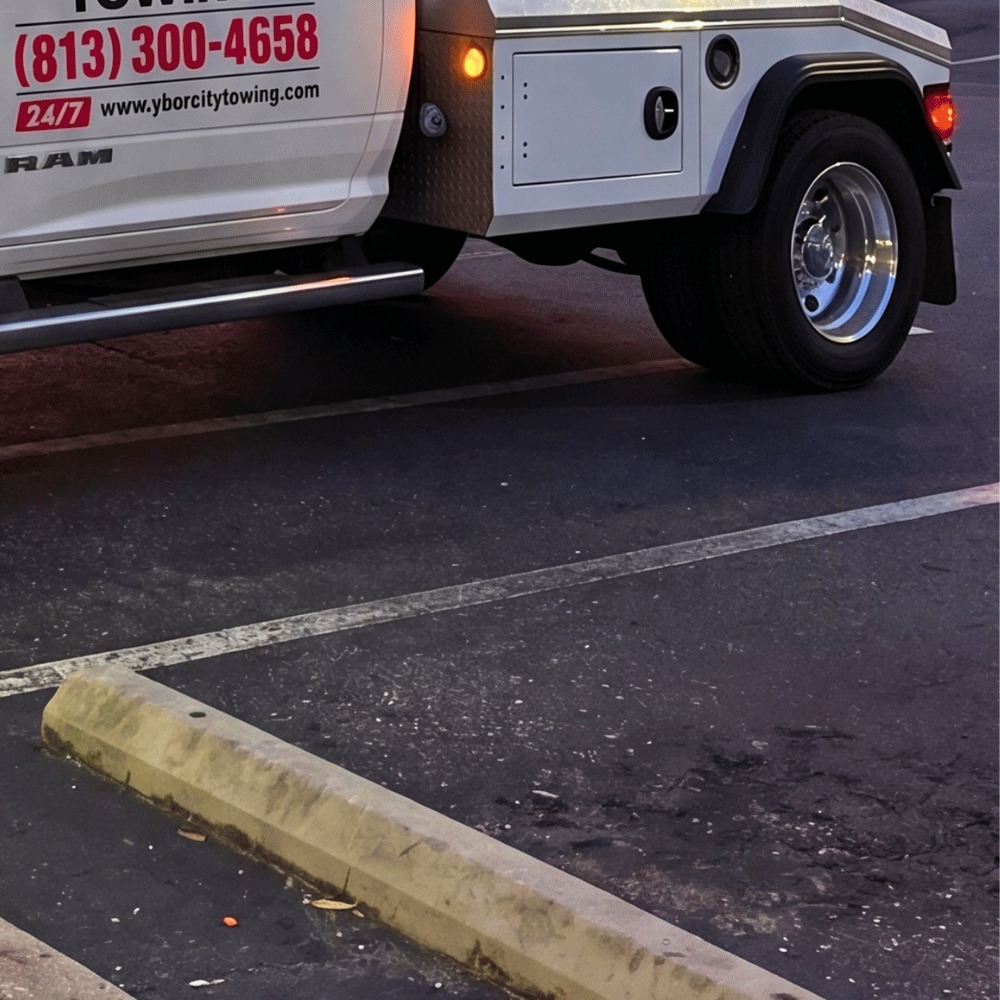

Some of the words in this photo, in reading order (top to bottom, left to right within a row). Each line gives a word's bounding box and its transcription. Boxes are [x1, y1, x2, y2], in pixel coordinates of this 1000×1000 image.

[14, 27, 122, 88] (813)
[131, 12, 319, 76] 300-4658
[25, 101, 84, 128] 24/7
[100, 83, 320, 118] www.yborcitytowing.com
[4, 148, 113, 174] RAM
